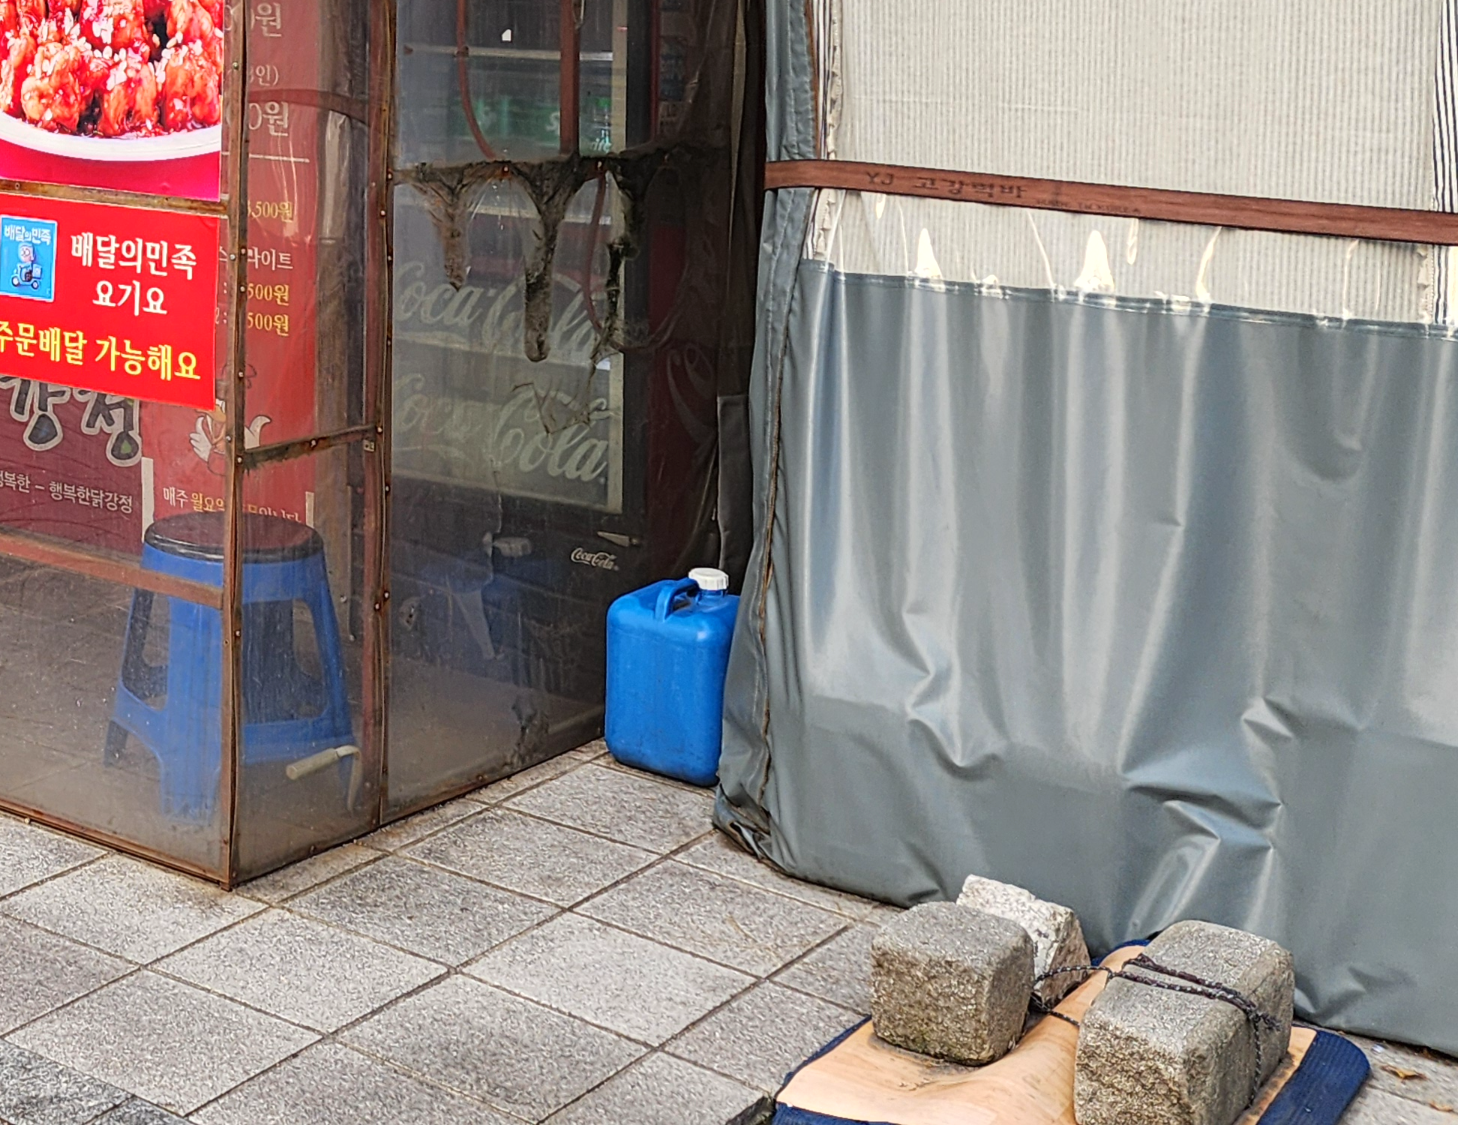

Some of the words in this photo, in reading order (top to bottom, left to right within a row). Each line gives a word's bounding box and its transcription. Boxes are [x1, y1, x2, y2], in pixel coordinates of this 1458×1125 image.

[866, 171, 895, 186] YJ
[4, 224, 52, 246] 배달의민족
[70, 231, 198, 281] 배달의민족
[92, 280, 168, 317] 요기요
[94, 335, 202, 382] 가능해요
[49, 479, 134, 514] 행복한닭강정
[163, 486, 189, 509] 매주
